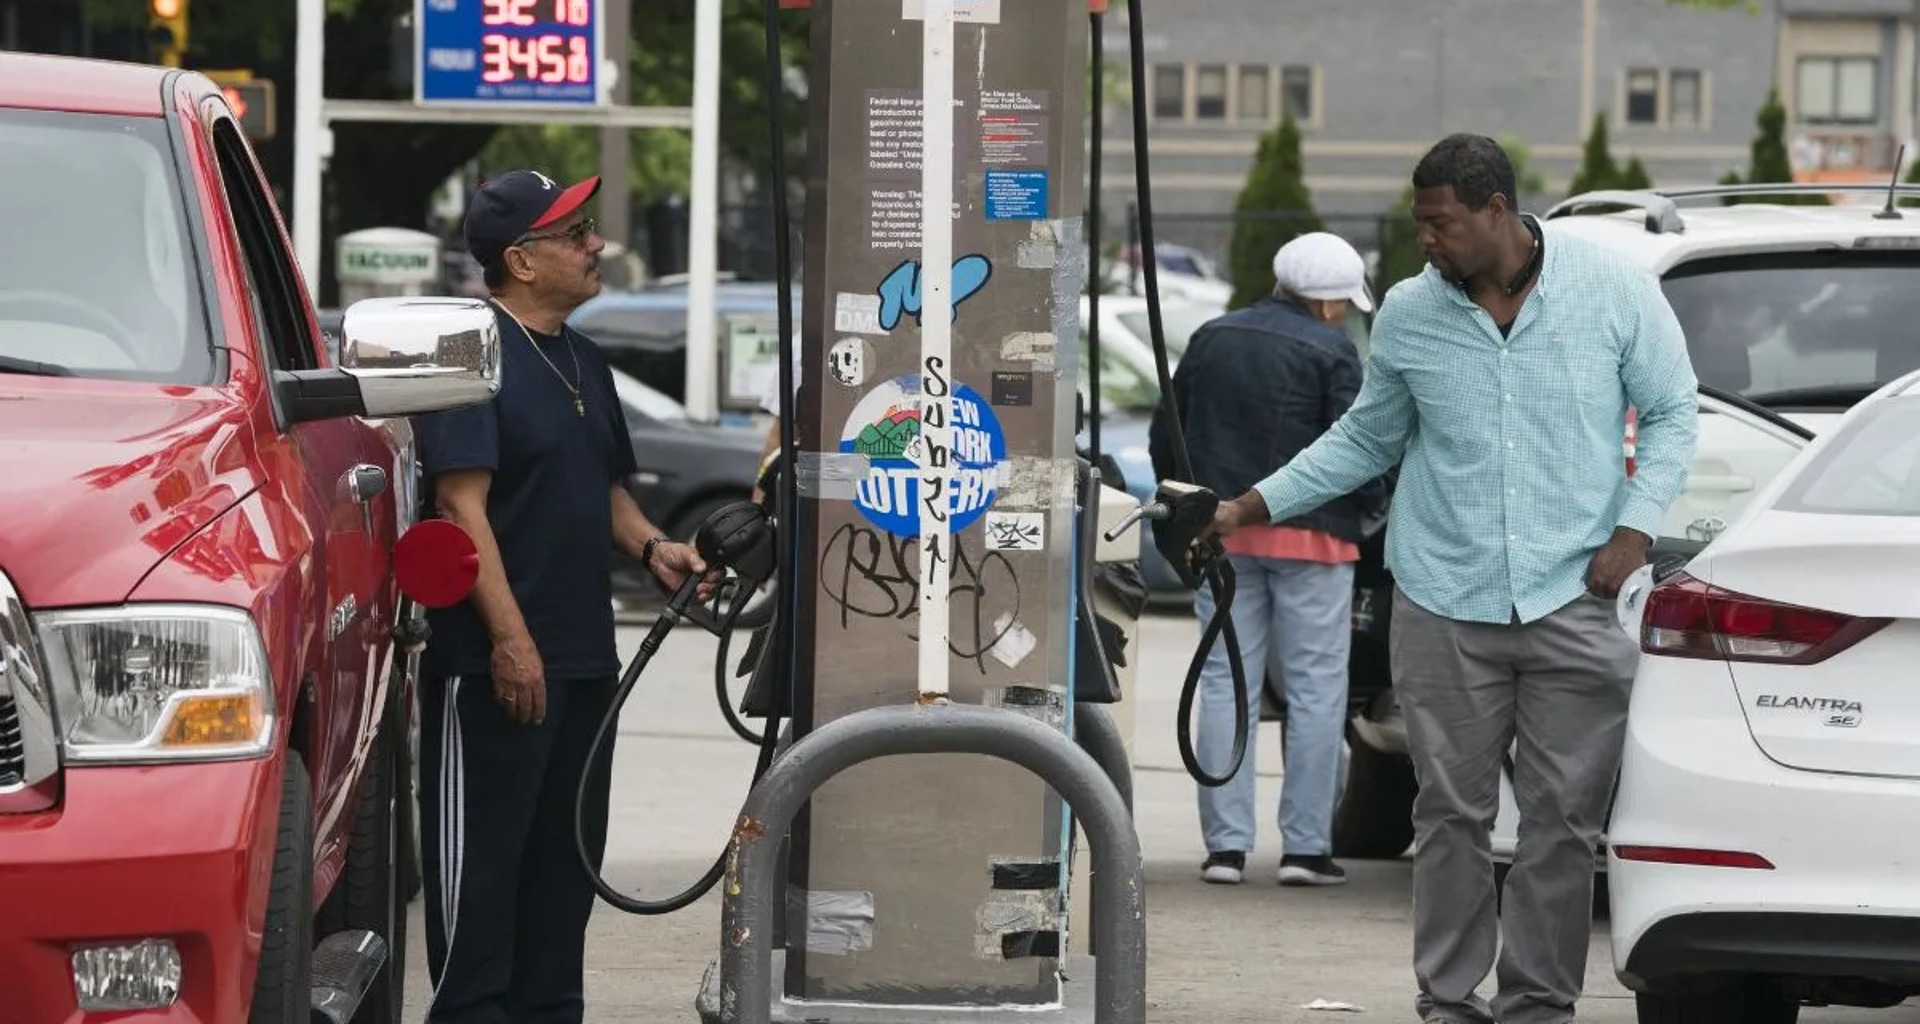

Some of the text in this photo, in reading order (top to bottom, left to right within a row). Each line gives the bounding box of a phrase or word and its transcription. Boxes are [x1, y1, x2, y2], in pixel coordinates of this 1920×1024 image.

[869, 97, 898, 105] Federal
[900, 97, 914, 105] law
[869, 120, 902, 129] gasoline
[902, 140, 923, 148] moto
[869, 160, 903, 169] Gasoline
[871, 240, 904, 250] properly
[950, 396, 980, 428] EW
[950, 425, 991, 463] ORK
[1755, 694, 1862, 713] ELANTRA
[1829, 715, 1855, 725] SE
